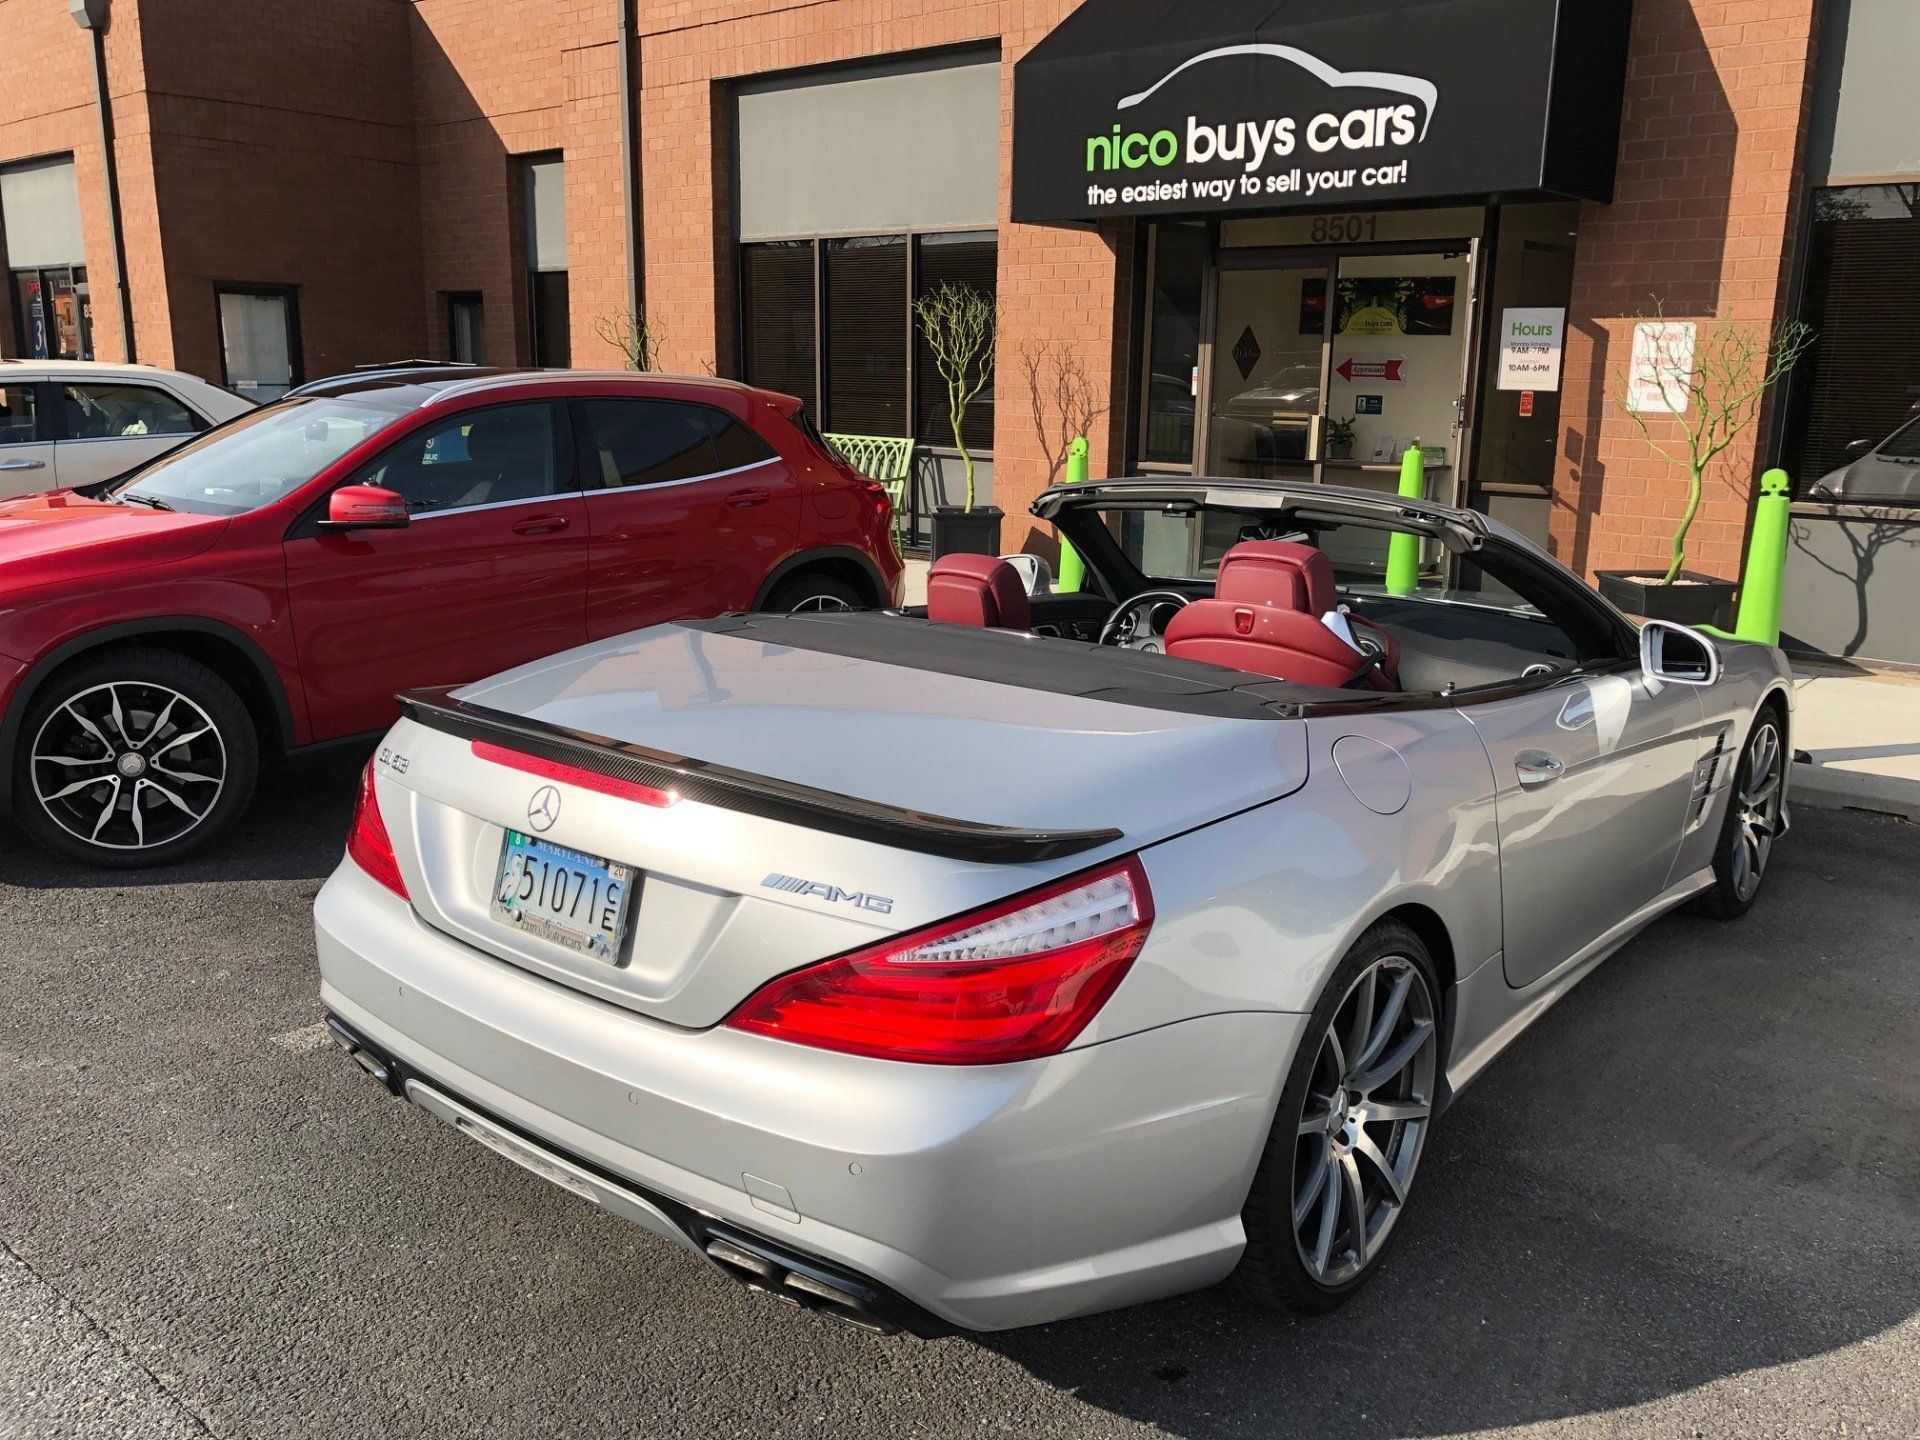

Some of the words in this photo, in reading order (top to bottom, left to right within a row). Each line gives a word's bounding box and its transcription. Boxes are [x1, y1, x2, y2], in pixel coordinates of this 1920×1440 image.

[1086, 124, 1178, 171] nico
[1186, 116, 1296, 171] buys
[1306, 104, 1415, 152] cars
[1087, 184, 1116, 206] the
[1121, 179, 1188, 204] easiest
[1192, 176, 1235, 201] way
[1240, 173, 1260, 195] to
[1266, 169, 1300, 193] sell
[1306, 167, 1356, 195] your
[1361, 160, 1408, 184] car!
[1310, 215, 1377, 242] 8501
[1511, 322, 1553, 336] Hours
[514, 833, 522, 846] 8
[799, 880, 894, 914] AMG
